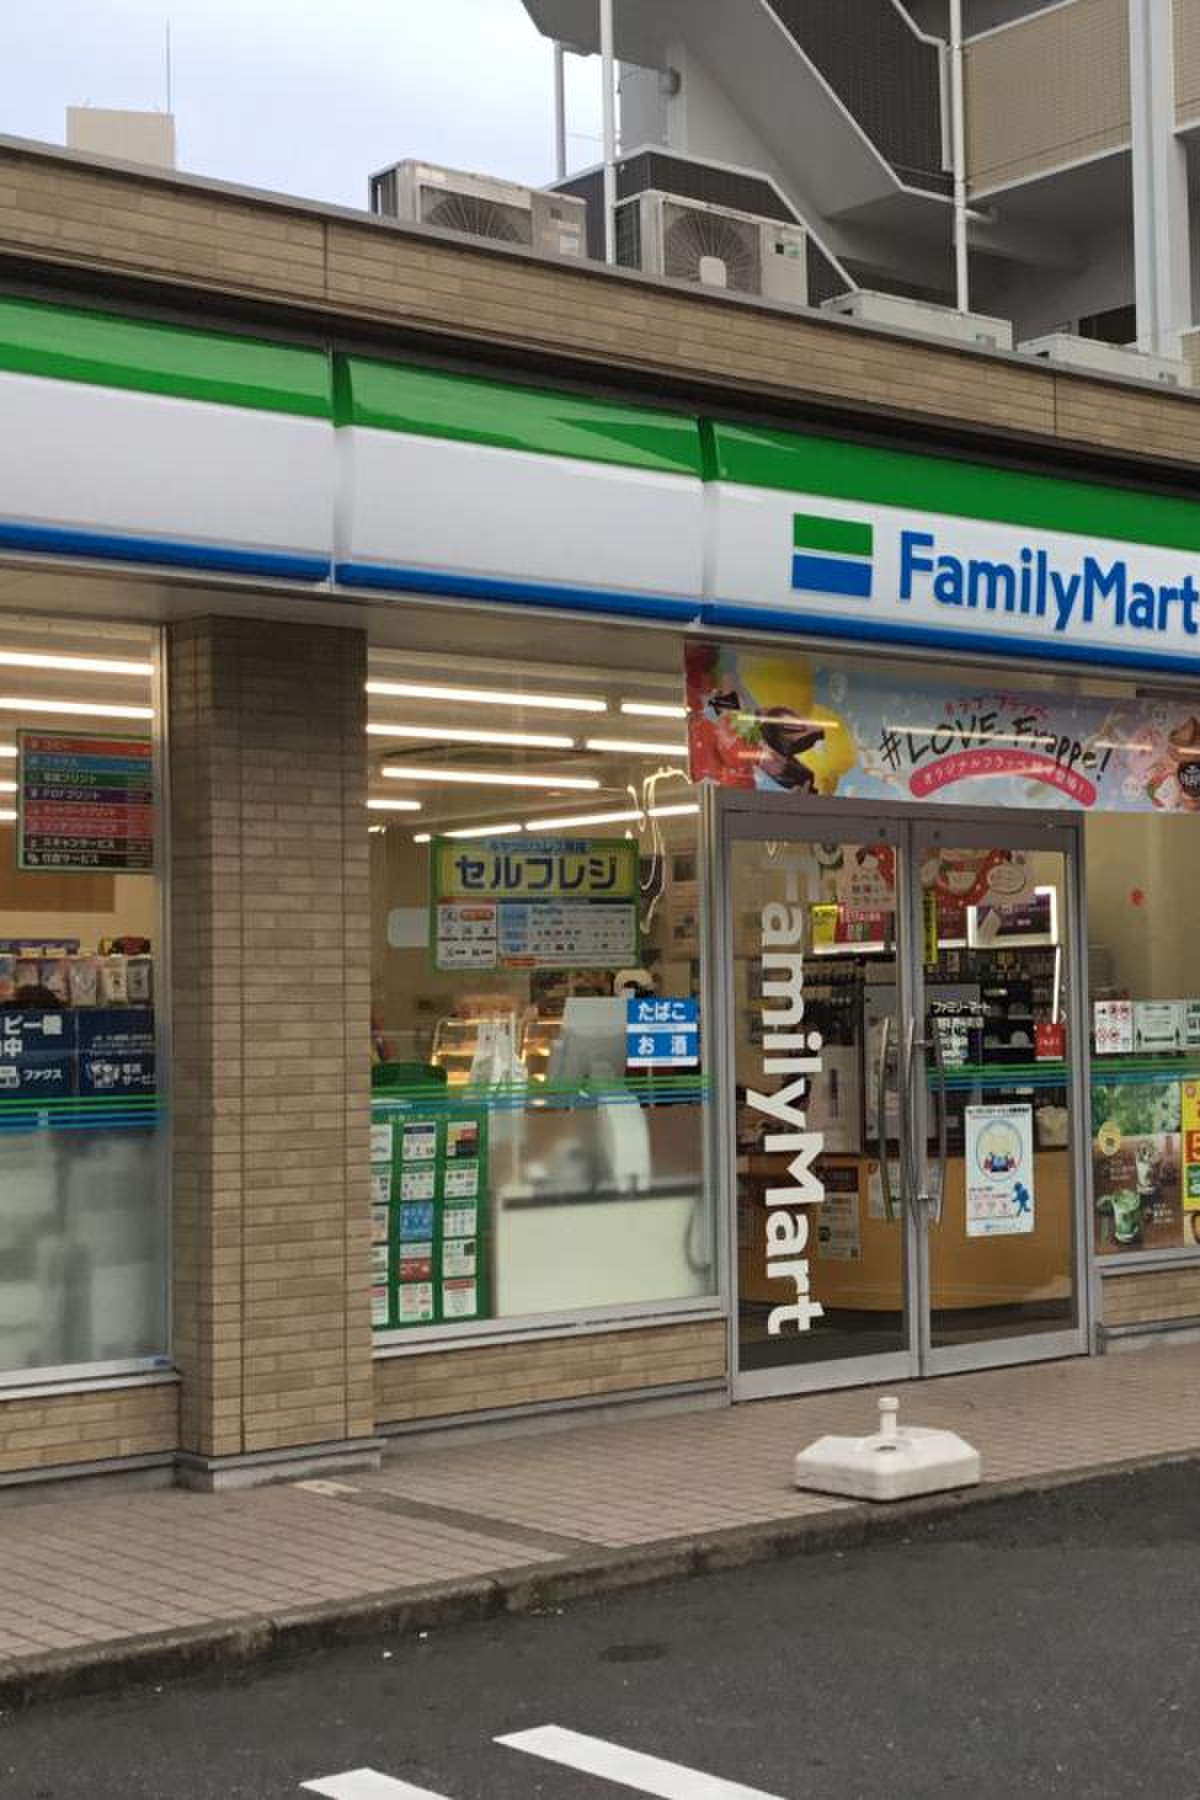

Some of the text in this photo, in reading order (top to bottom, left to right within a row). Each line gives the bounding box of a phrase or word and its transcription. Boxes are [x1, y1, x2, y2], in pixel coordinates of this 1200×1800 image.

[899, 529, 1200, 635] FamilyMart
[455, 855, 618, 889] セルフレジ
[638, 1001, 687, 1021] たばこ
[745, 856, 827, 1335] FamilyMart
